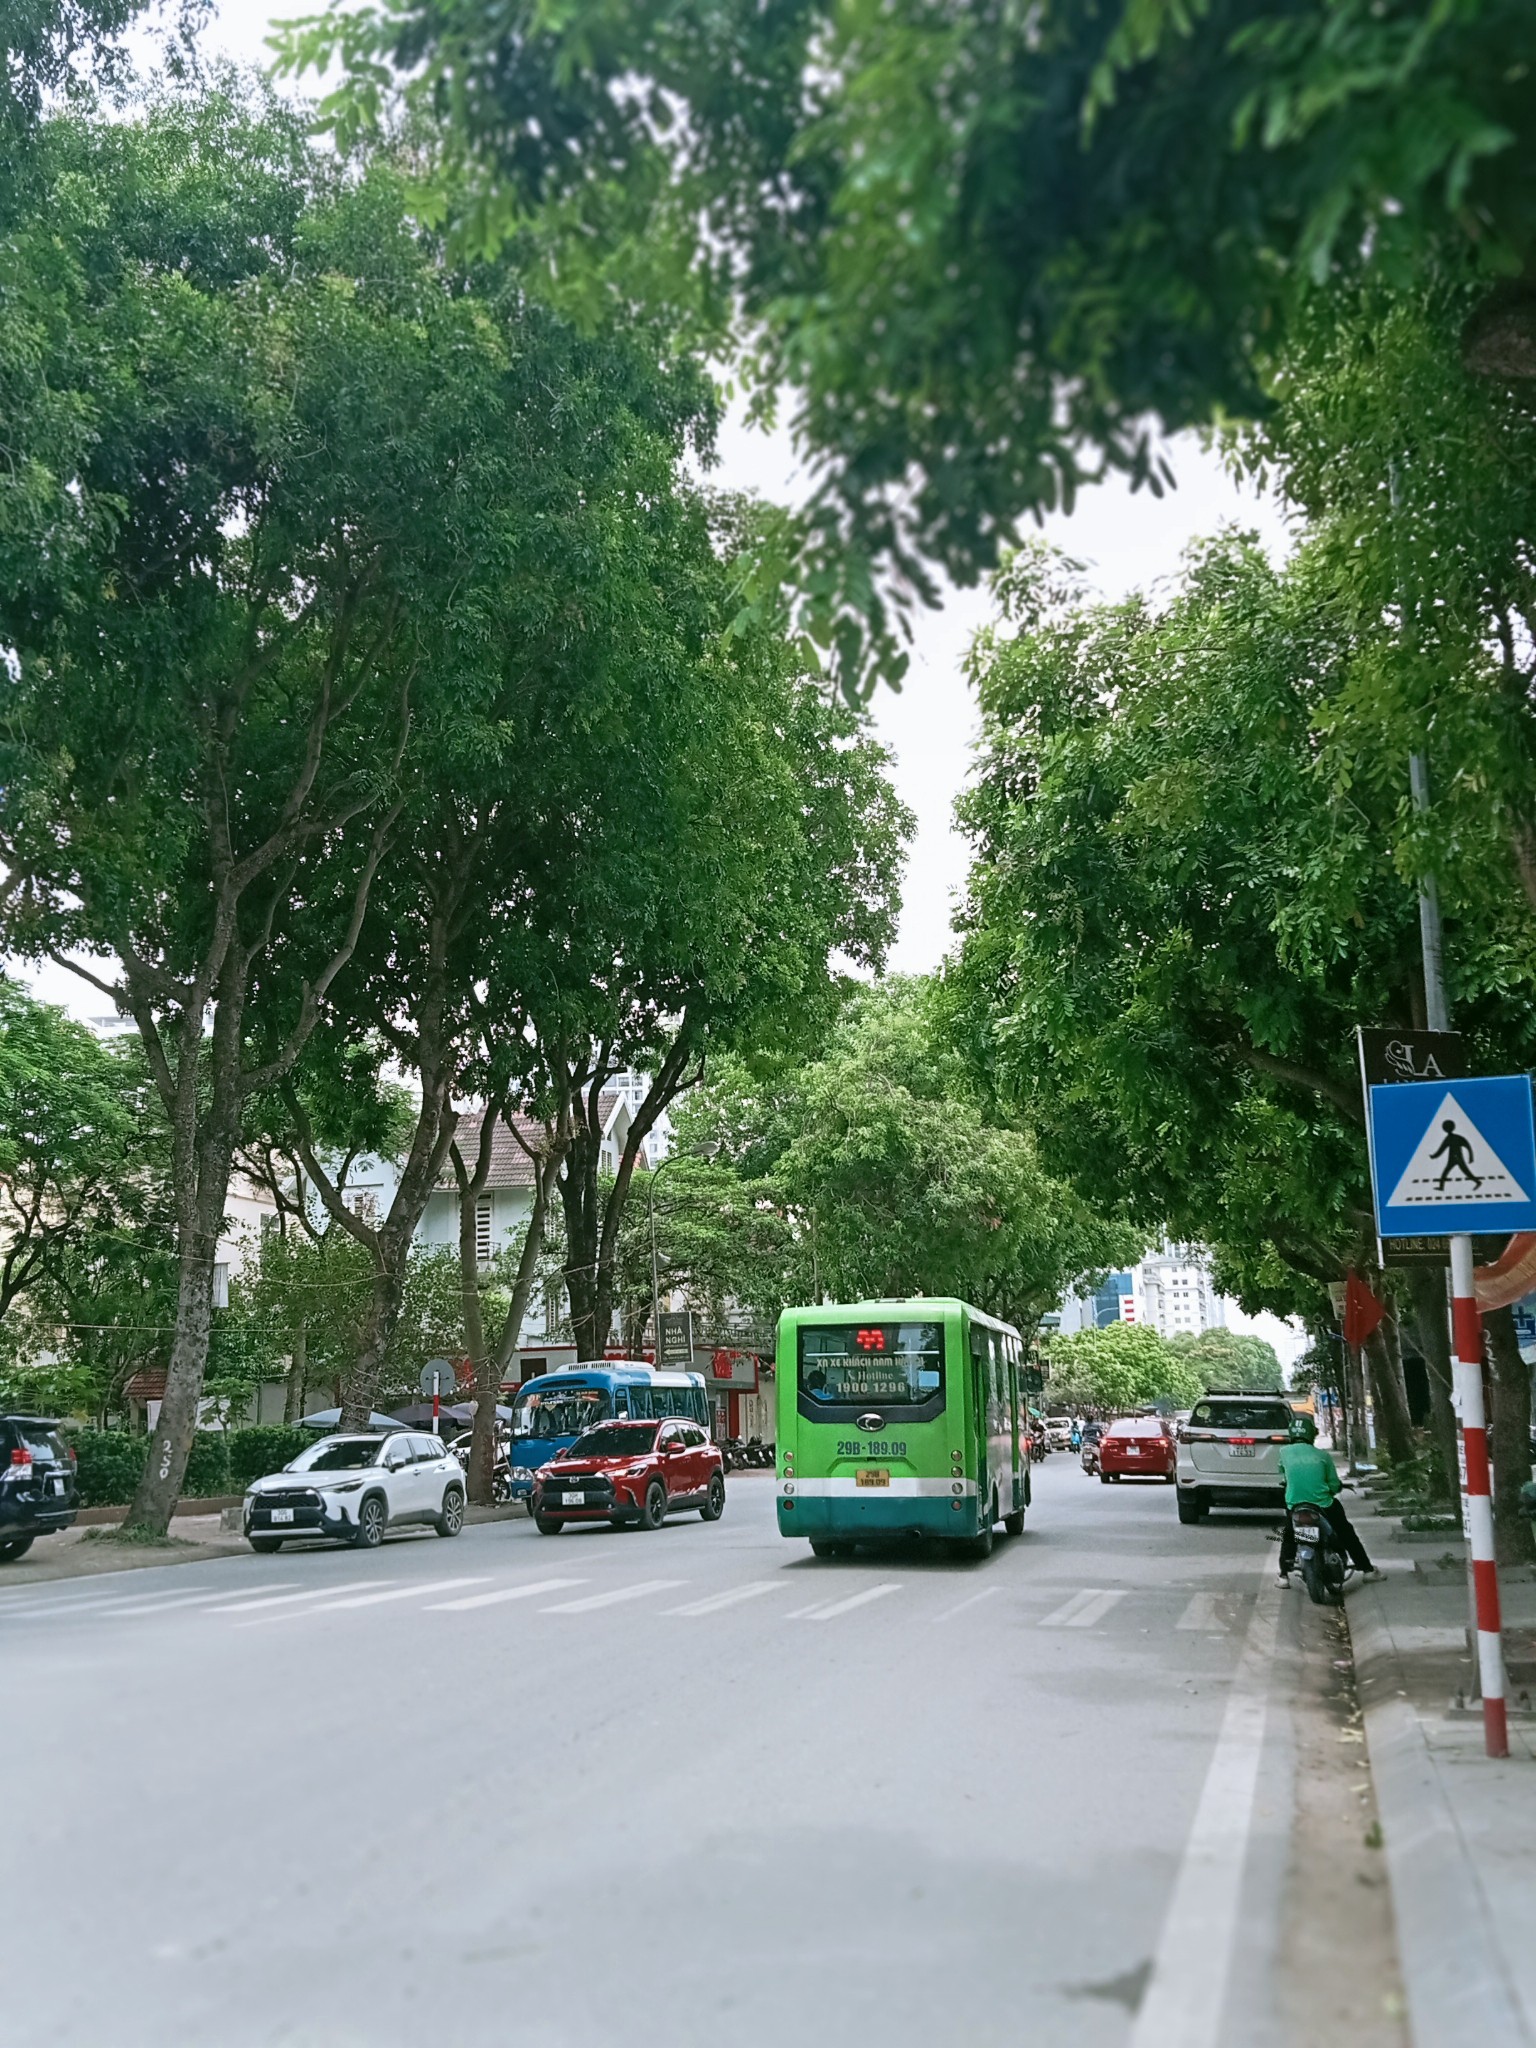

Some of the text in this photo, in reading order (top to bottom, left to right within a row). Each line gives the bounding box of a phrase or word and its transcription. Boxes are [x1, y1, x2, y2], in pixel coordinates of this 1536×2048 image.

[858, 1371, 894, 1381] Hotline
[836, 1382, 906, 1394] 1900 1296
